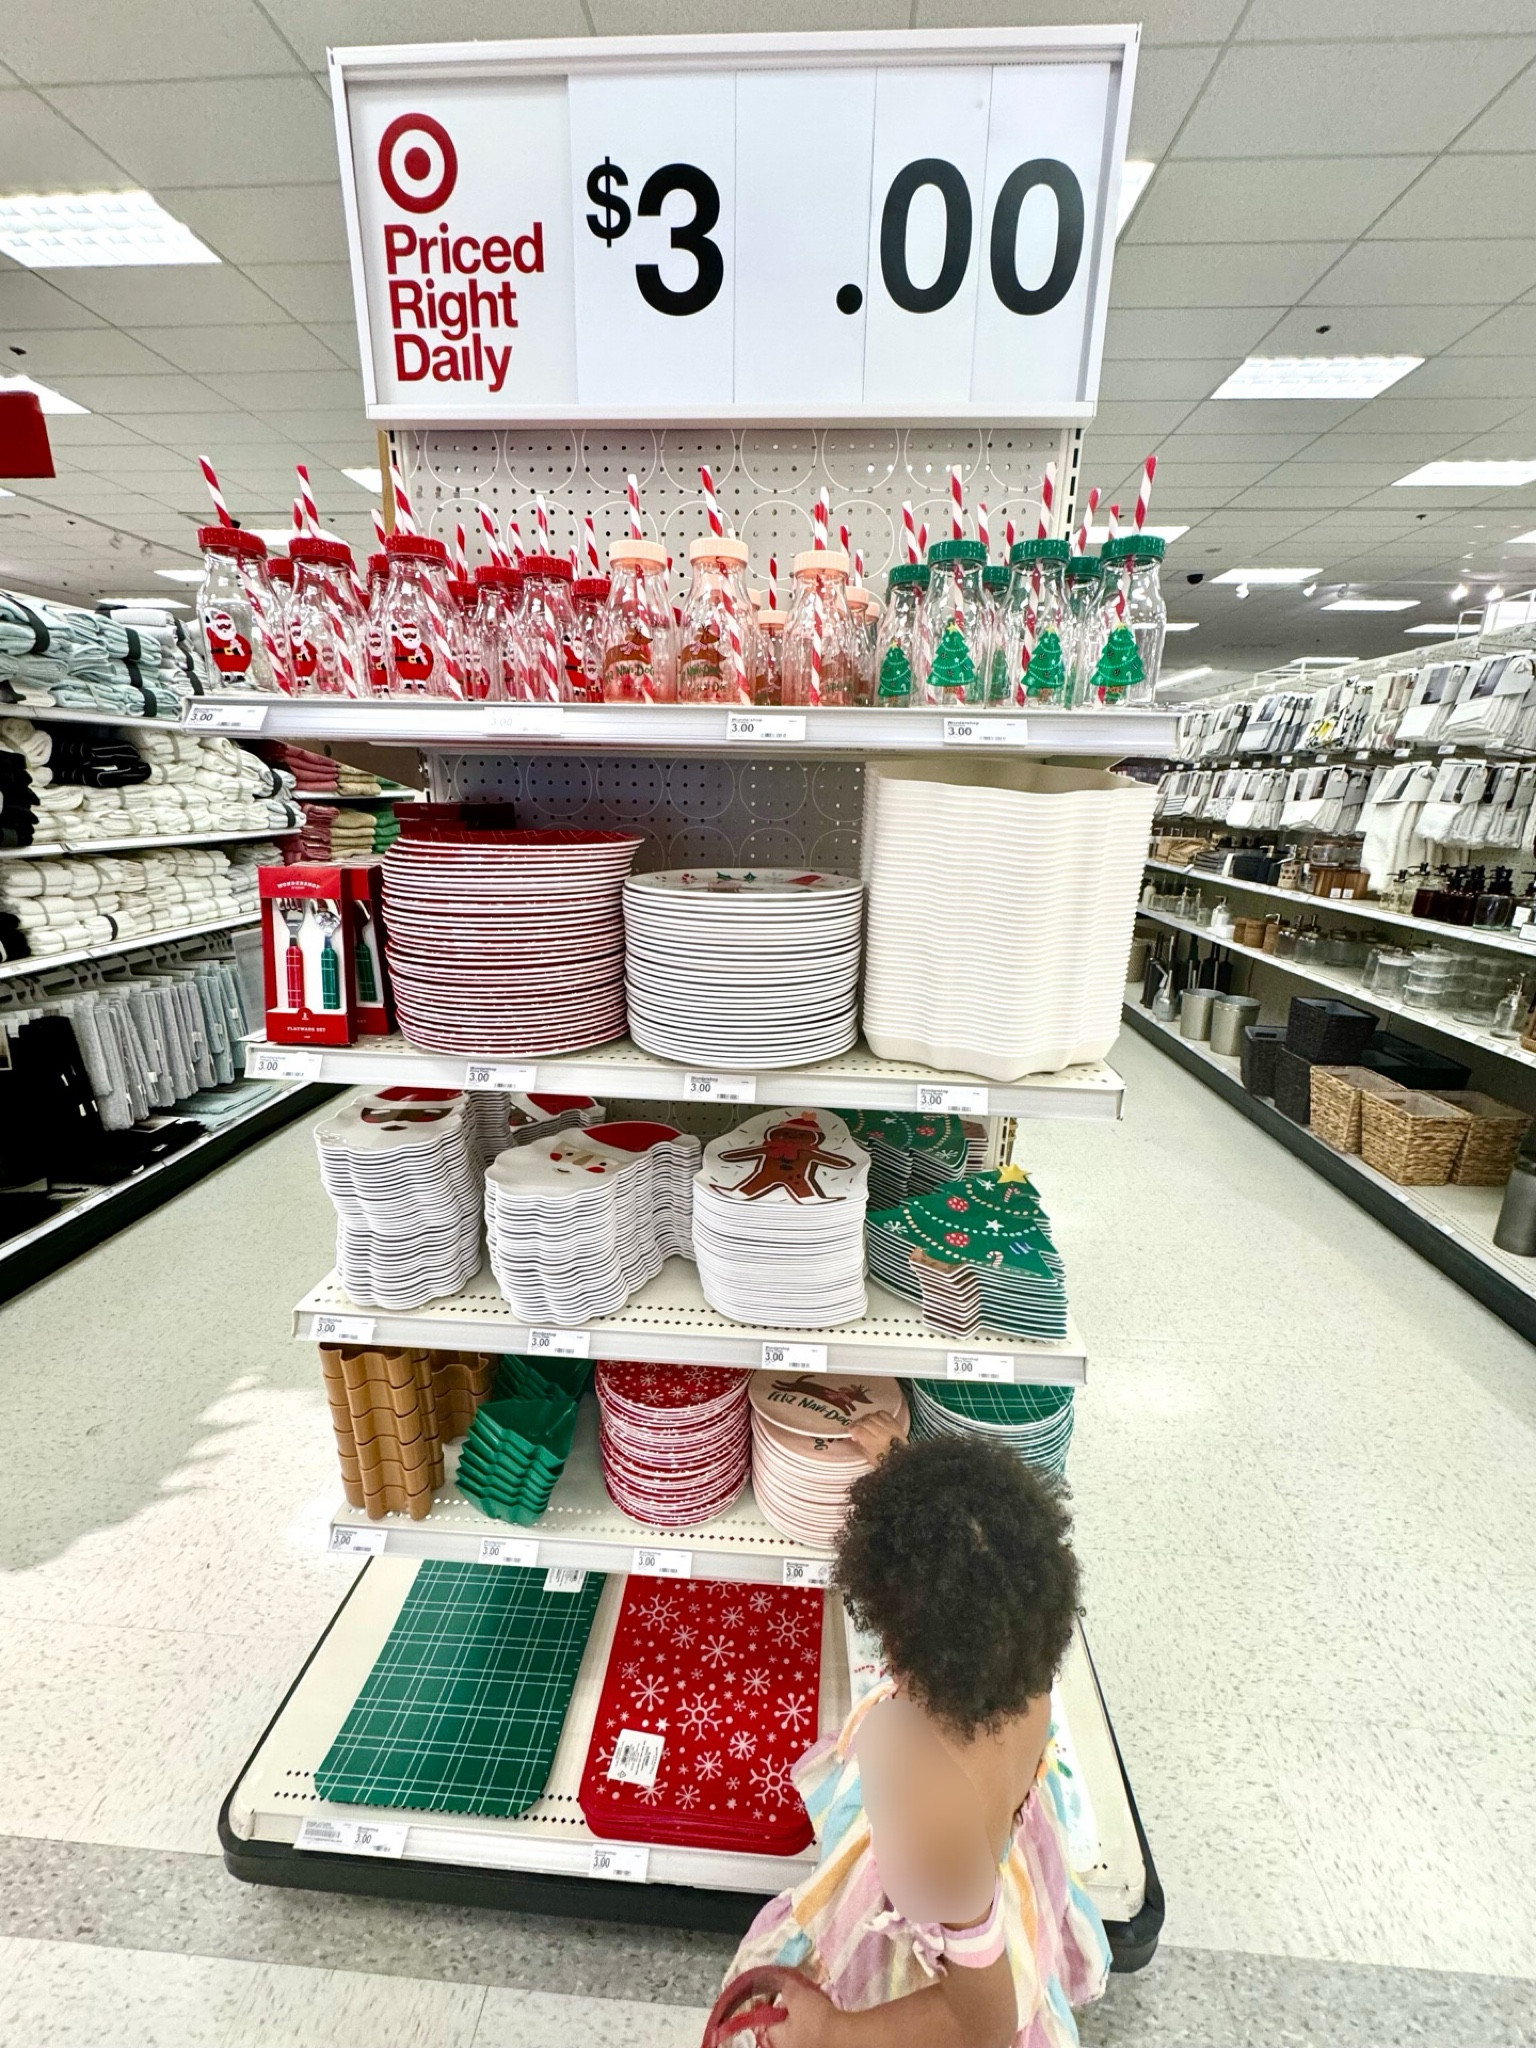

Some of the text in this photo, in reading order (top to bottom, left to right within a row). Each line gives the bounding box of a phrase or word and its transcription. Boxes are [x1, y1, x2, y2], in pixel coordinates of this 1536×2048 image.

[384, 222, 544, 274] Priced
[389, 278, 519, 341] Right
[394, 333, 513, 393] Daily
[190, 713, 214, 722] 3.00
[731, 723, 754, 733] 3.00
[947, 726, 972, 736] 3.00
[258, 1061, 278, 1071] 3.00
[468, 1072, 490, 1082] 3.00
[690, 1083, 711, 1093] 3.00
[920, 1095, 942, 1105] 3.00
[316, 1323, 336, 1333] 3.00
[531, 1337, 550, 1347] 3.00
[764, 1351, 784, 1362] 3.00
[953, 1362, 973, 1372] 3.00
[333, 1535, 351, 1545] 3.00
[482, 1546, 500, 1556] 3.00
[638, 1556, 656, 1567] 3.00
[786, 1567, 804, 1578] 3.00
[354, 1833, 372, 1844] 3.00
[593, 1856, 611, 1868] 3.00
